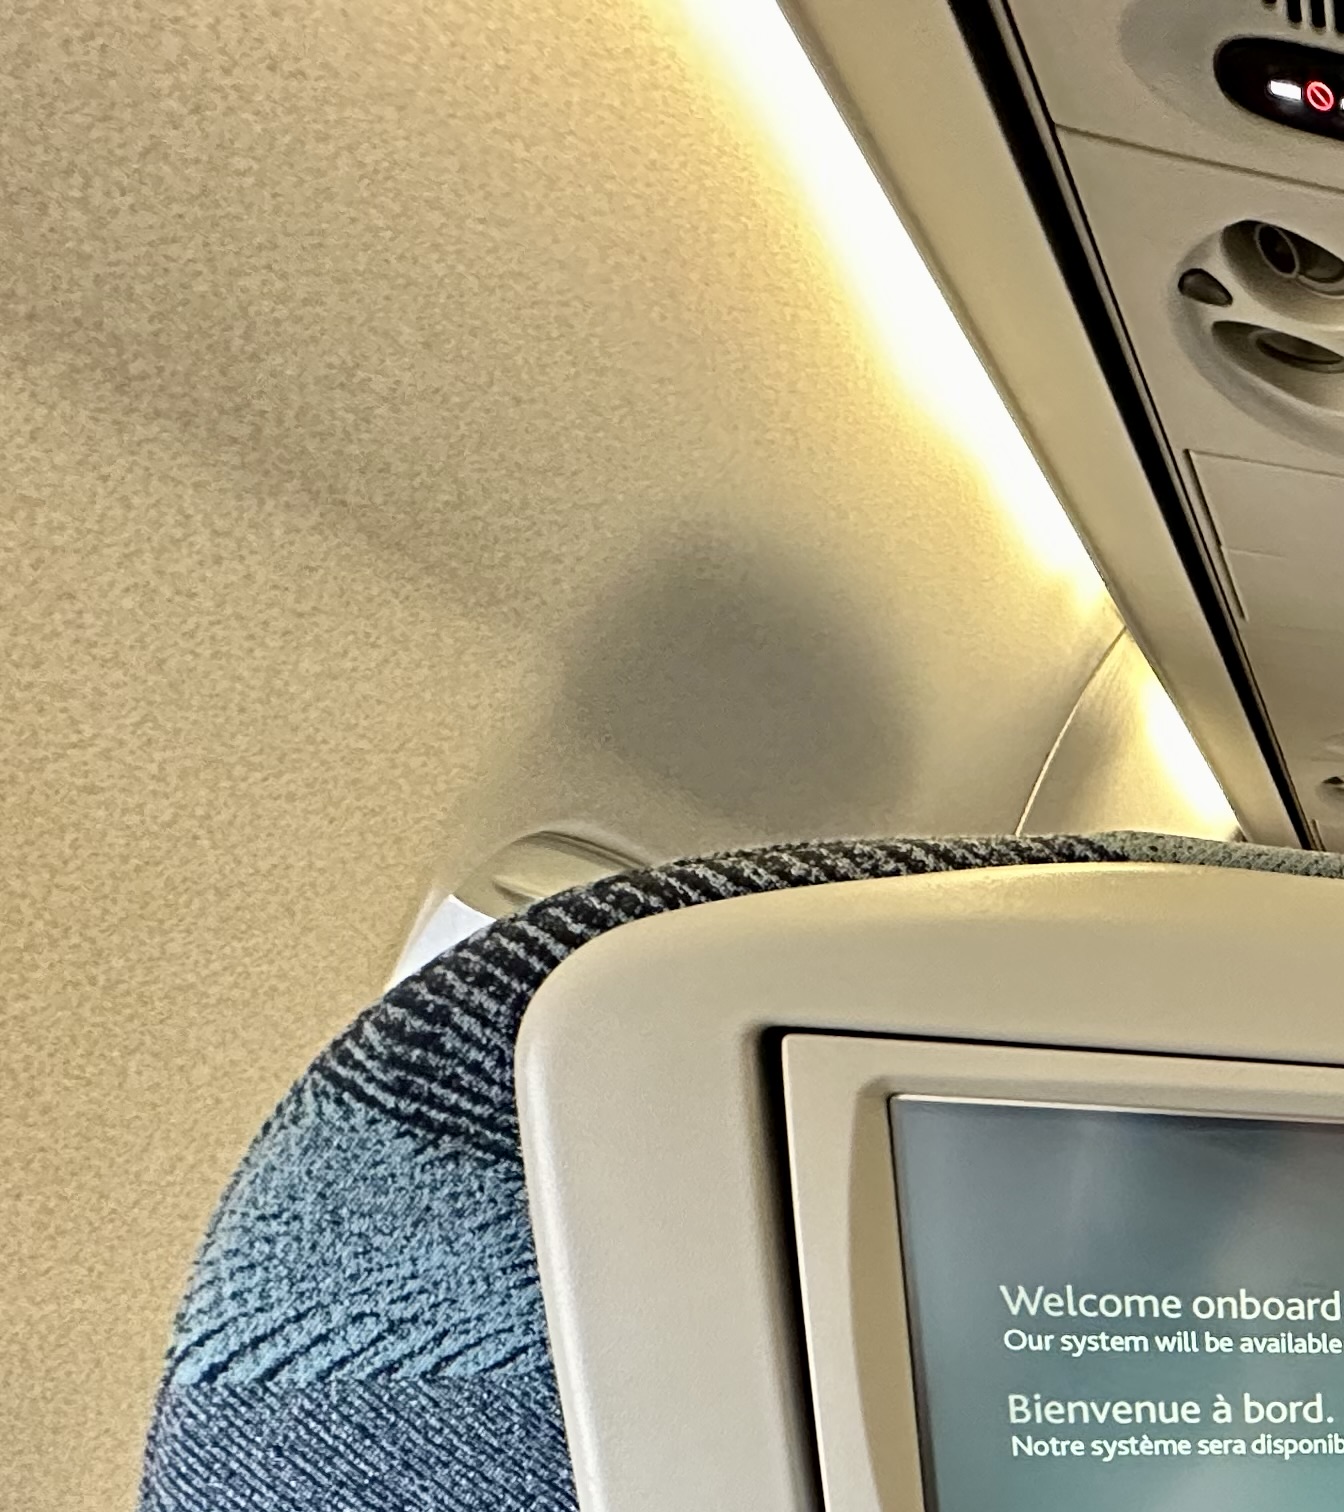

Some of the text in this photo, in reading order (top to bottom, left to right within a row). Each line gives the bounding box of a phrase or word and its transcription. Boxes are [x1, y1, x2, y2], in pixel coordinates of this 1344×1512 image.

[1000, 1285, 1182, 1318] Welcome
[1003, 1329, 1055, 1351] Our
[1060, 1331, 1149, 1357] system
[1154, 1331, 1199, 1352] will
[1204, 1331, 1233, 1353] be
[1239, 1332, 1342, 1355] available
[1008, 1393, 1335, 1424] Bienvenue à bord.
[1012, 1435, 1085, 1456] Notre
[1091, 1433, 1191, 1461] système
[1197, 1437, 1246, 1456] sera
